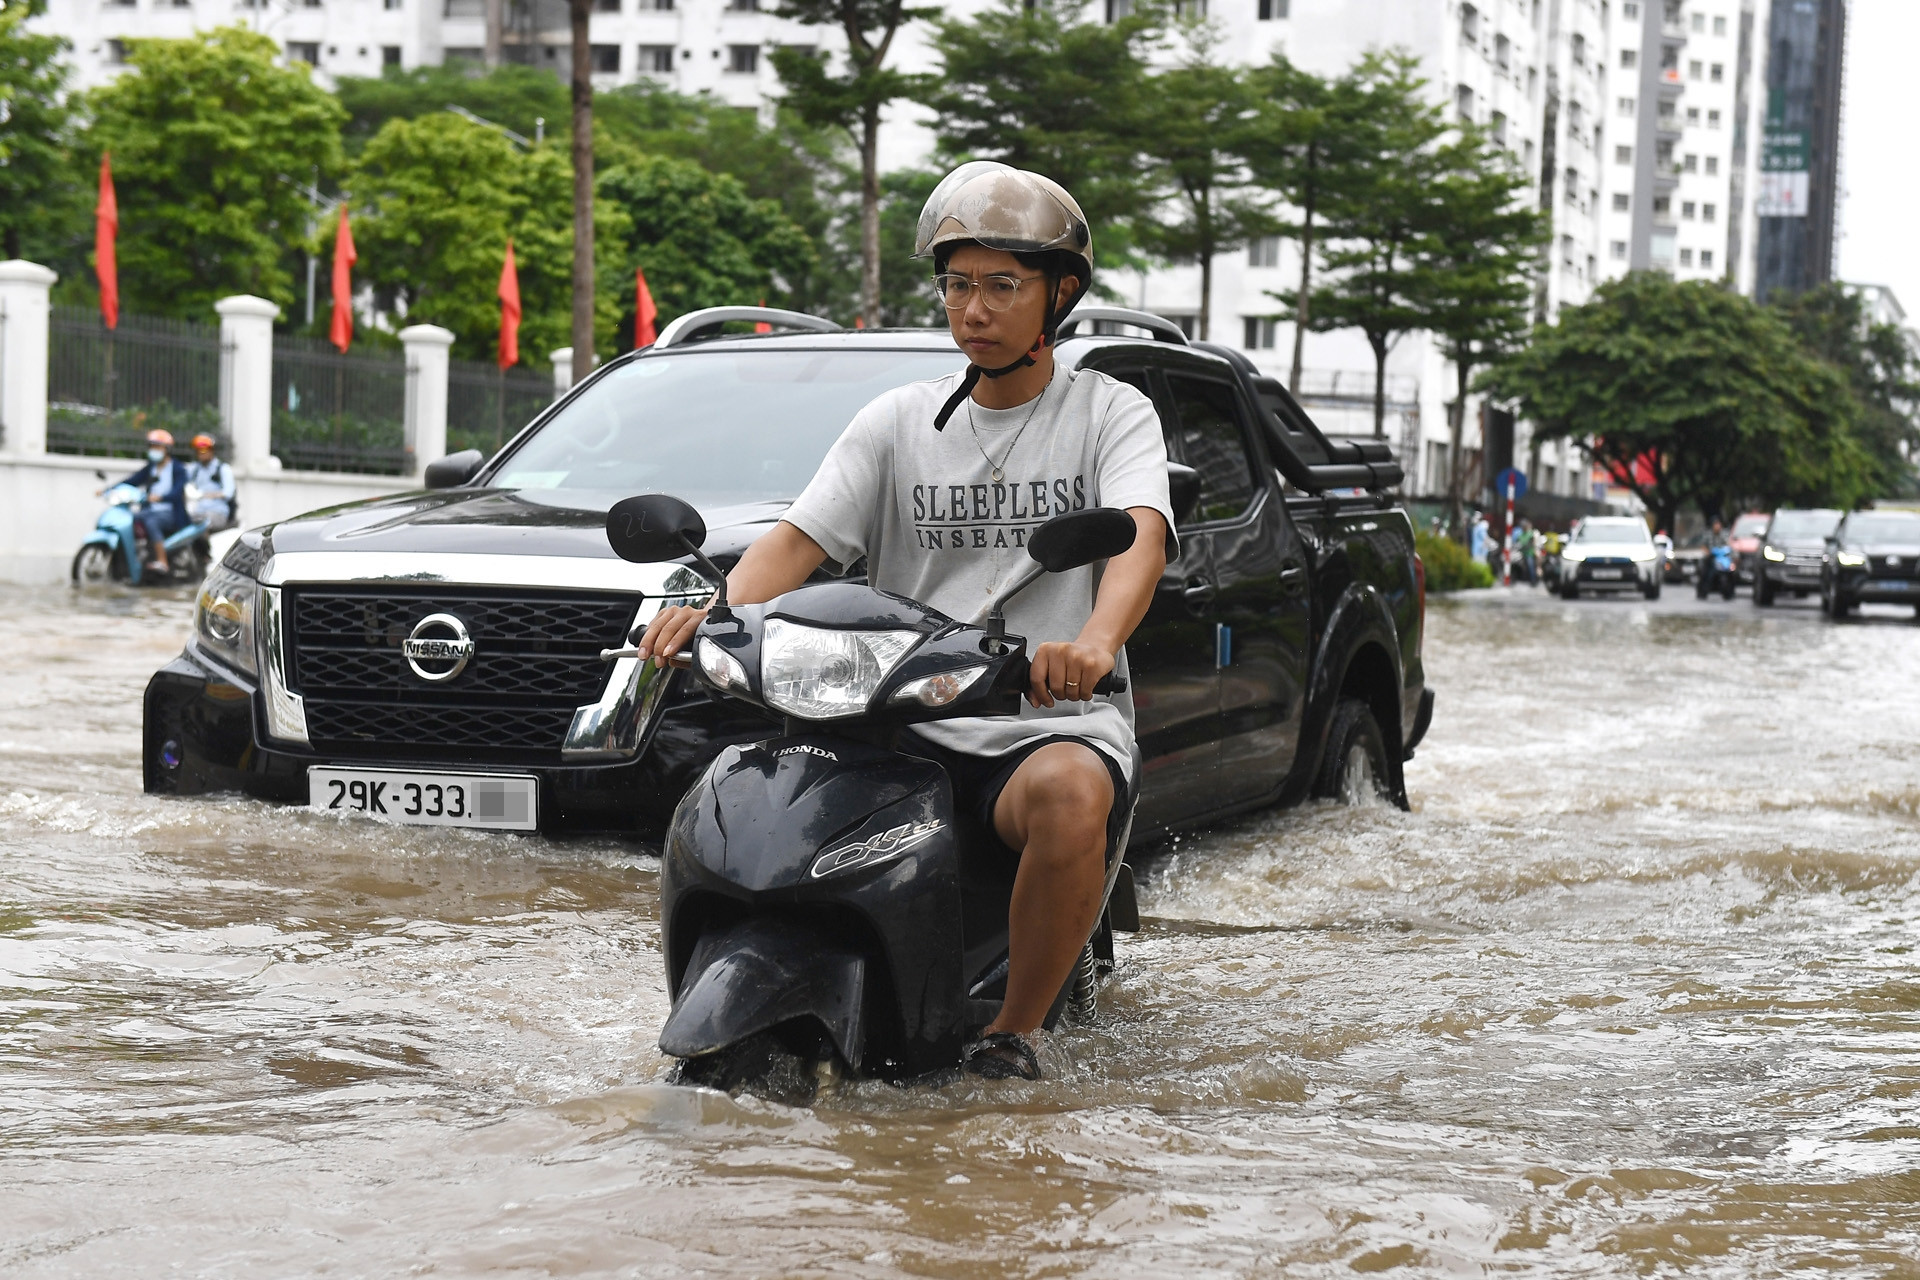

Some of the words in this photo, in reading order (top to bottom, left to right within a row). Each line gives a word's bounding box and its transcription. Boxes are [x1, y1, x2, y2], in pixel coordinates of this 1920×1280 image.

[912, 475, 1086, 522] SLEEPLESS
[405, 642, 464, 656] NISSAN
[778, 745, 839, 762] HONDA
[328, 780, 526, 819] 29K-333.
